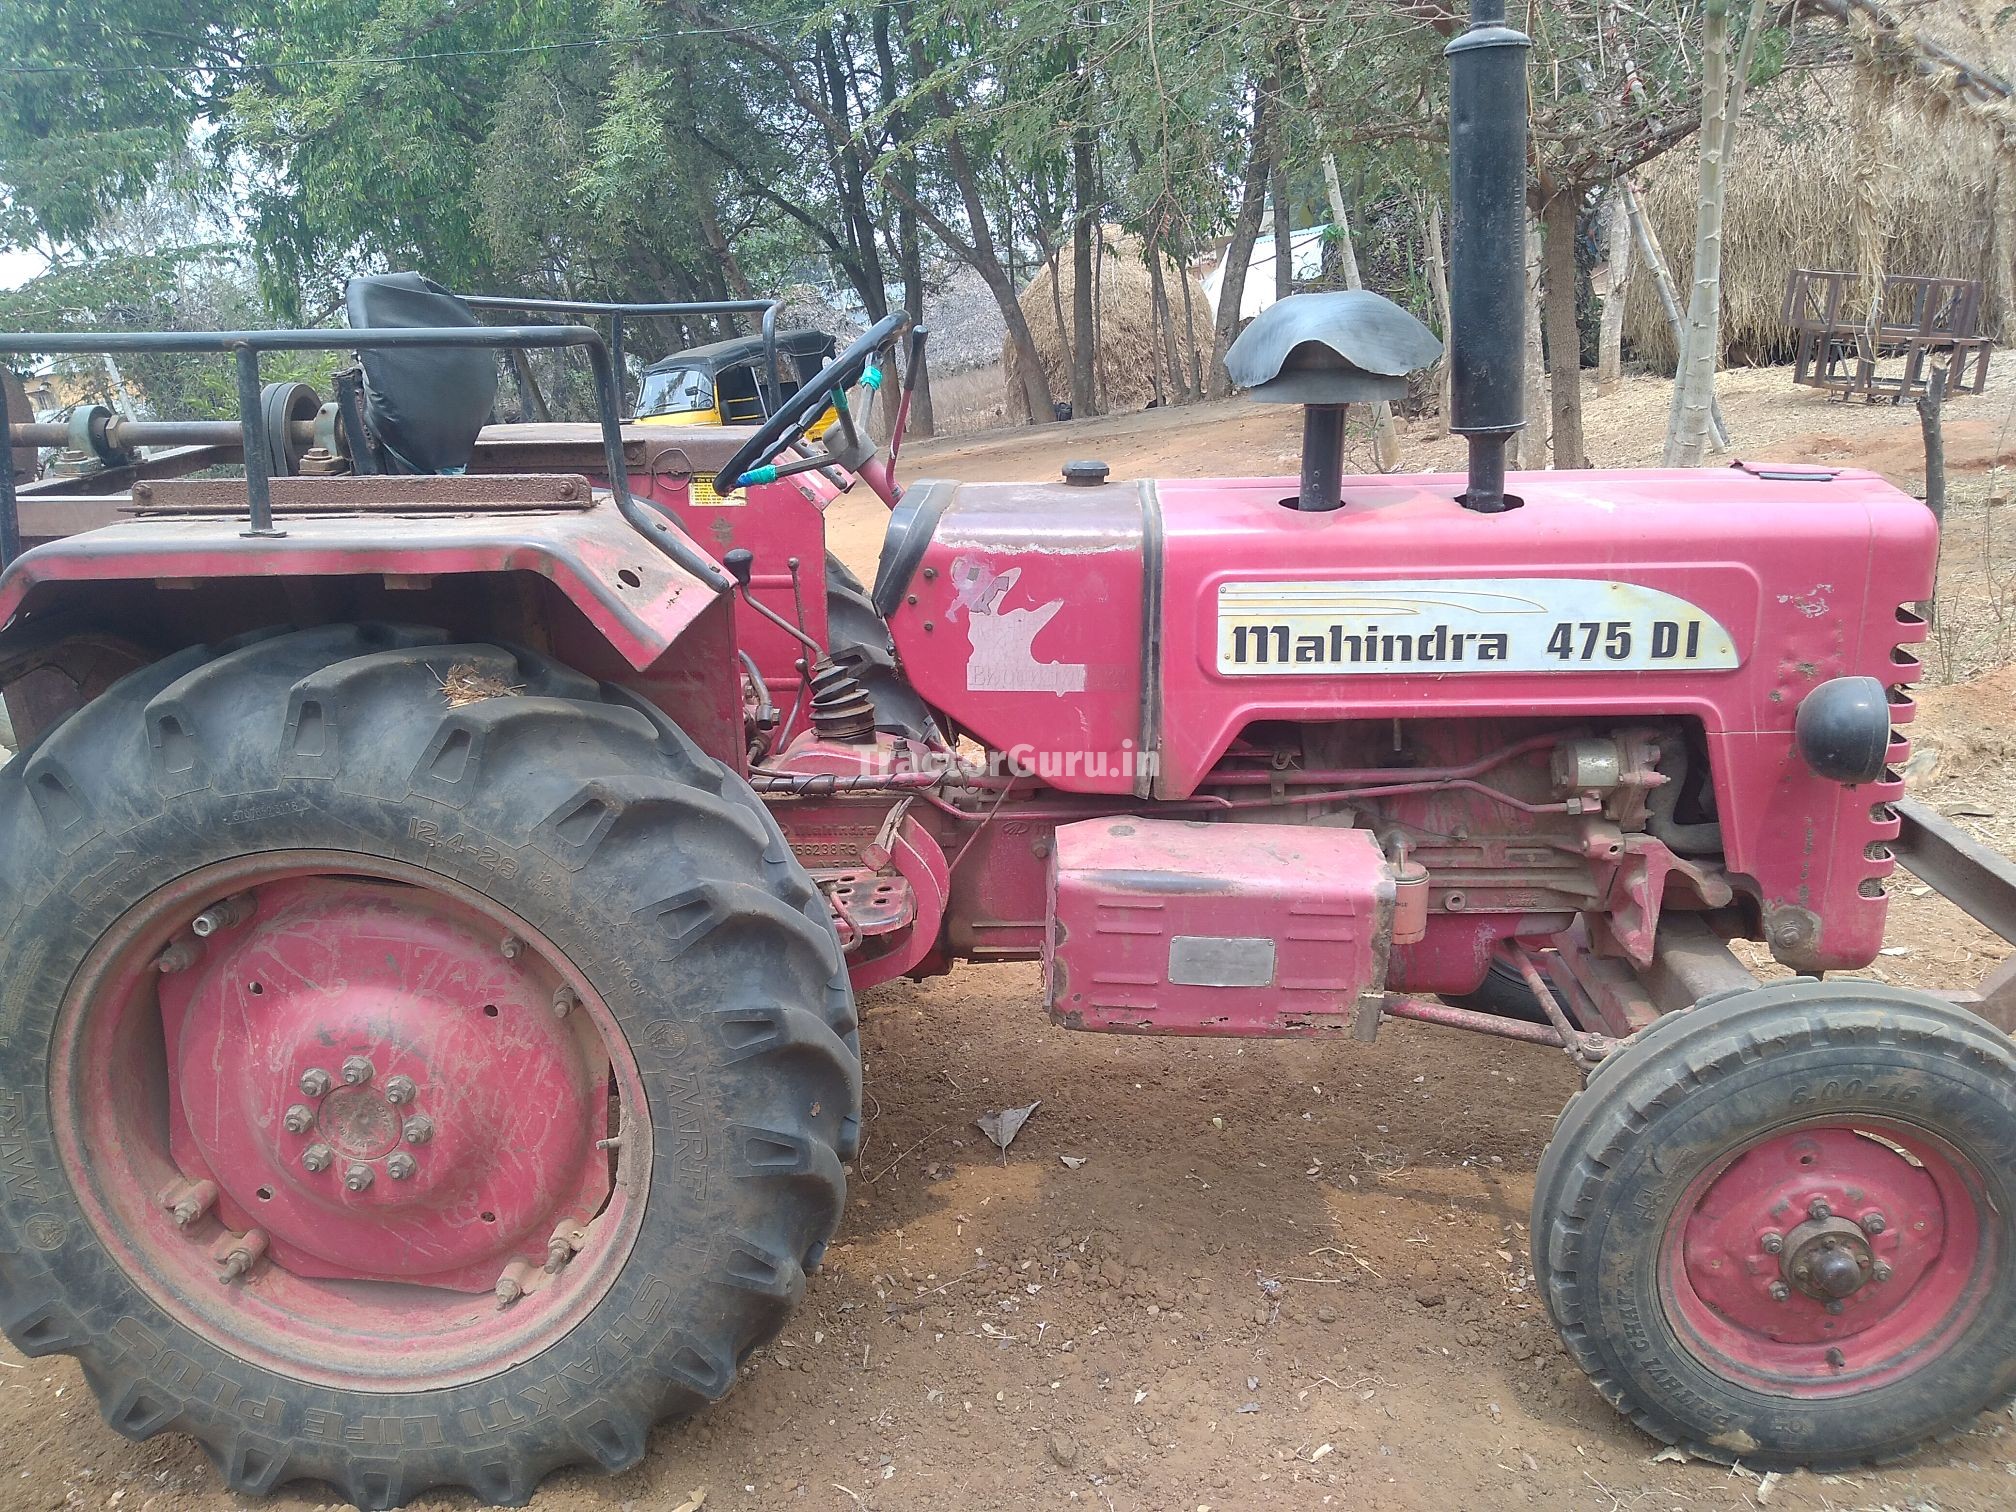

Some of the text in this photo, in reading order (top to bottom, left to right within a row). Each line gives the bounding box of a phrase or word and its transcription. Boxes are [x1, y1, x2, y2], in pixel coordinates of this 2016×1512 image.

[1233, 620, 1700, 663] Mahindra 475 DI
[409, 817, 519, 880] 12.4-28
[789, 842, 857, 856] 56238R3
[611, 956, 647, 997] NYLON
[1790, 1079, 1923, 1104] 6.00-16
[666, 1071, 710, 1201] MRF
[111, 1272, 672, 1446] SHAKTI LIFE PLUS
